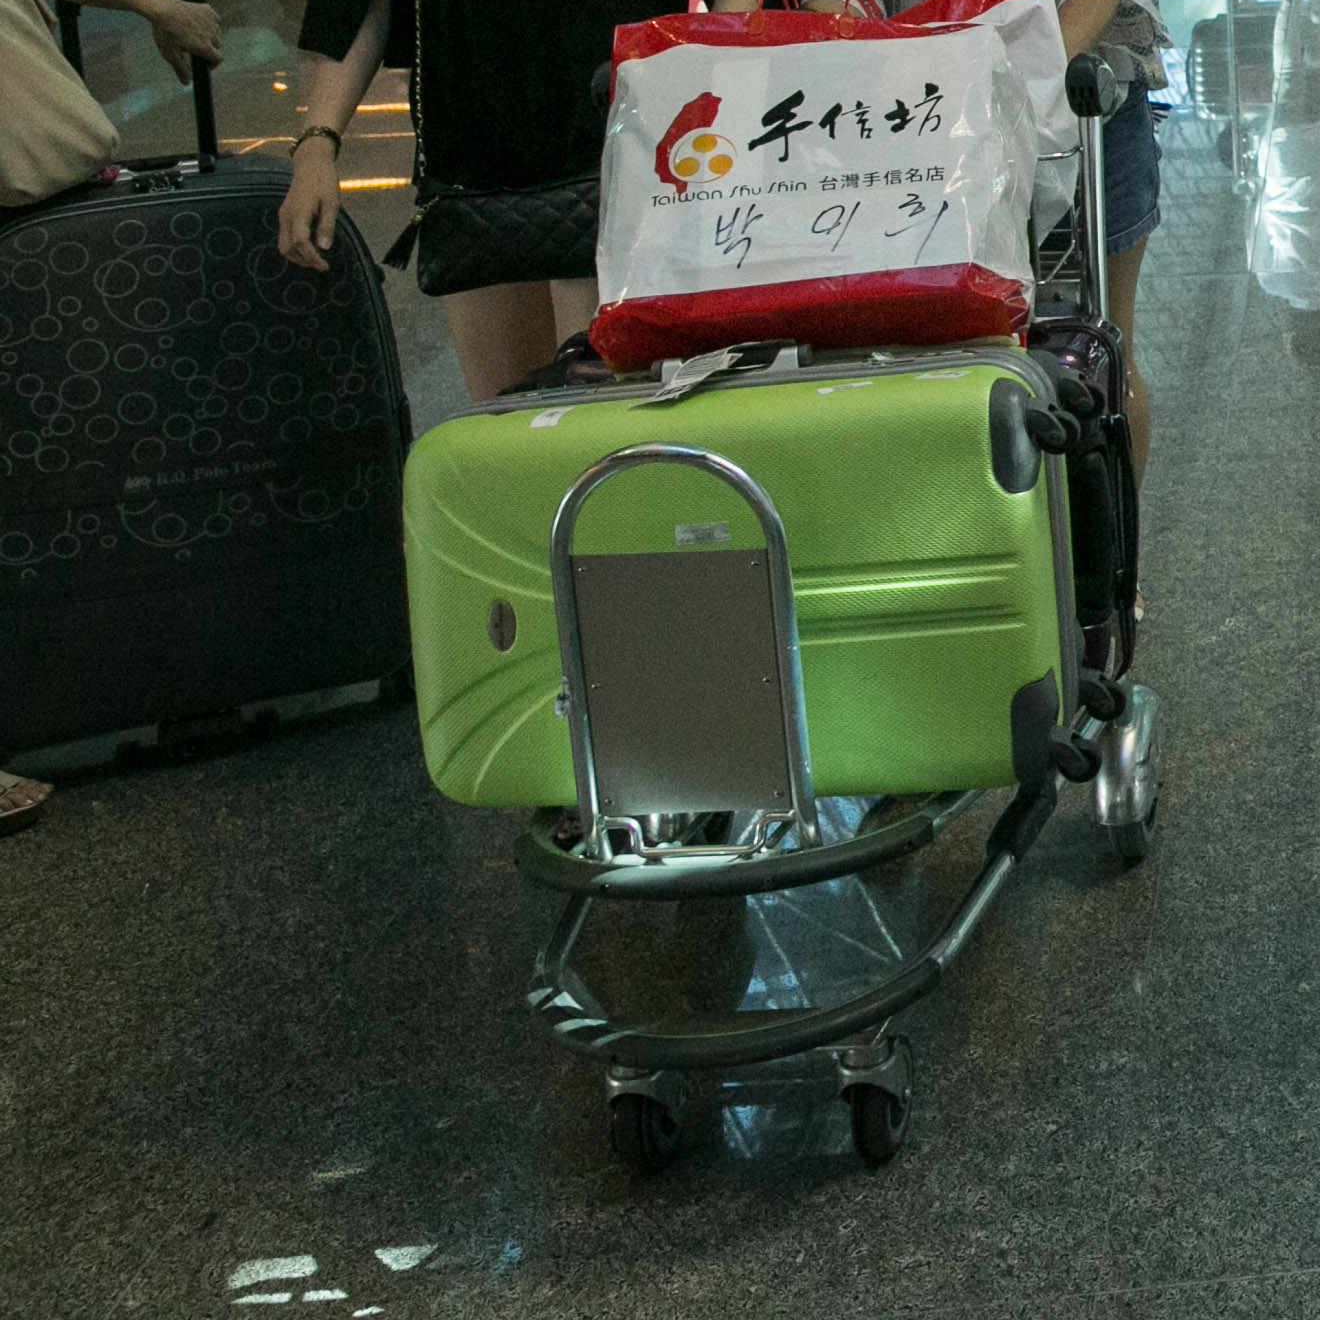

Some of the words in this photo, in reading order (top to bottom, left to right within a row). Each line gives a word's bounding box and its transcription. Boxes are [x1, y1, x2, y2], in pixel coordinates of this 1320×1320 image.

[747, 81, 945, 163] 手信坊
[650, 188, 724, 209] Taiwan
[819, 165, 946, 193] 台灣手信名店
